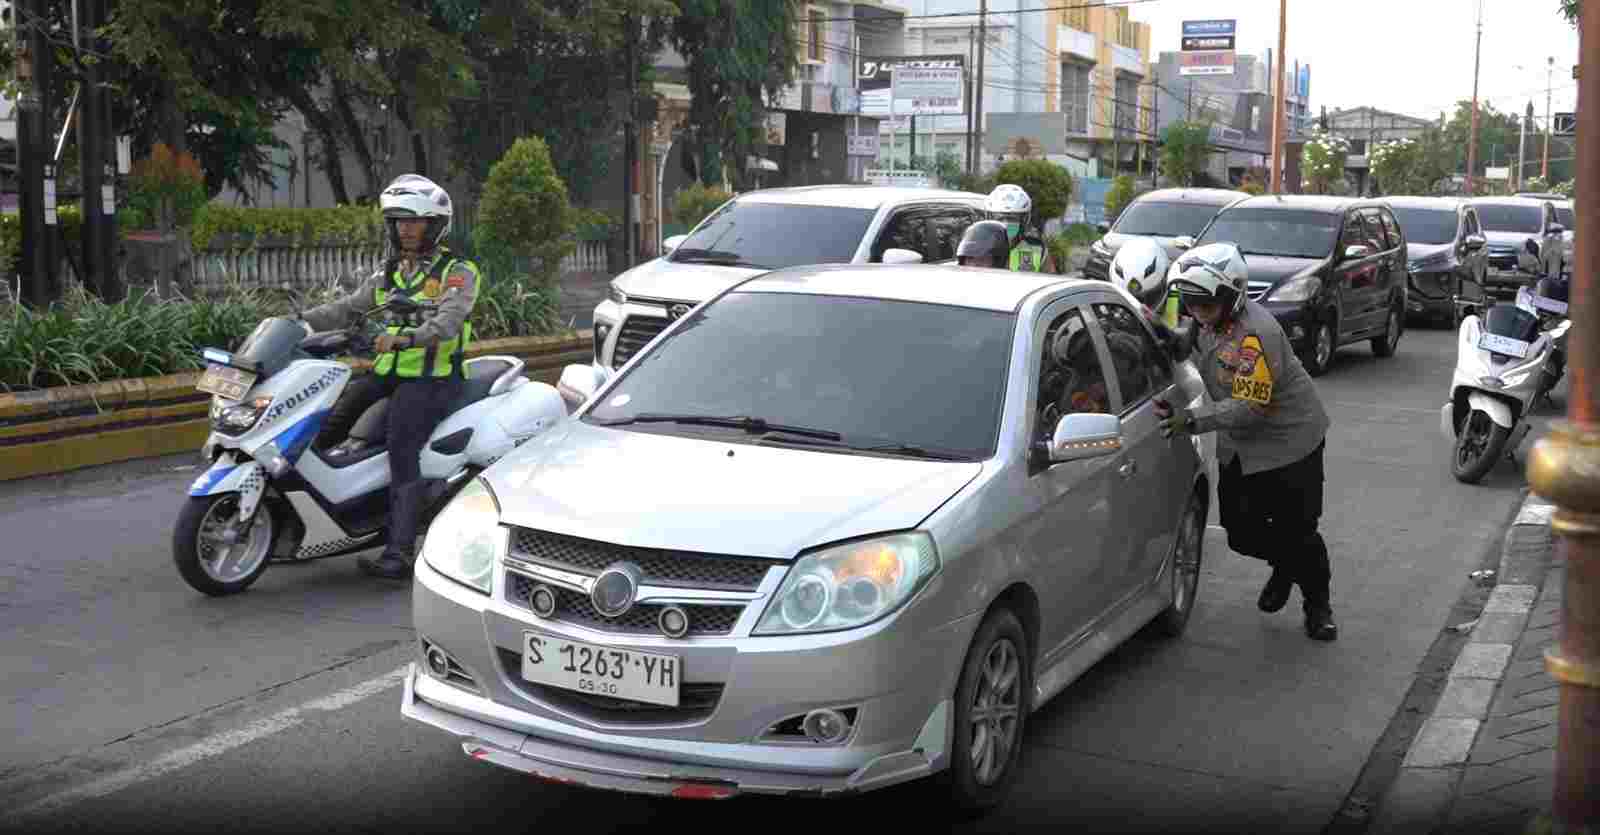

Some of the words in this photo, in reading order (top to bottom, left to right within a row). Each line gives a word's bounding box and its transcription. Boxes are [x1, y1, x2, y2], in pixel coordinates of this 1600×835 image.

[273, 378, 325, 417] POLISI
[1232, 377, 1252, 398] OPS
[1252, 381, 1270, 401] RES
[528, 636, 544, 665] S
[561, 644, 624, 680] 1263
[643, 655, 675, 689] YH
